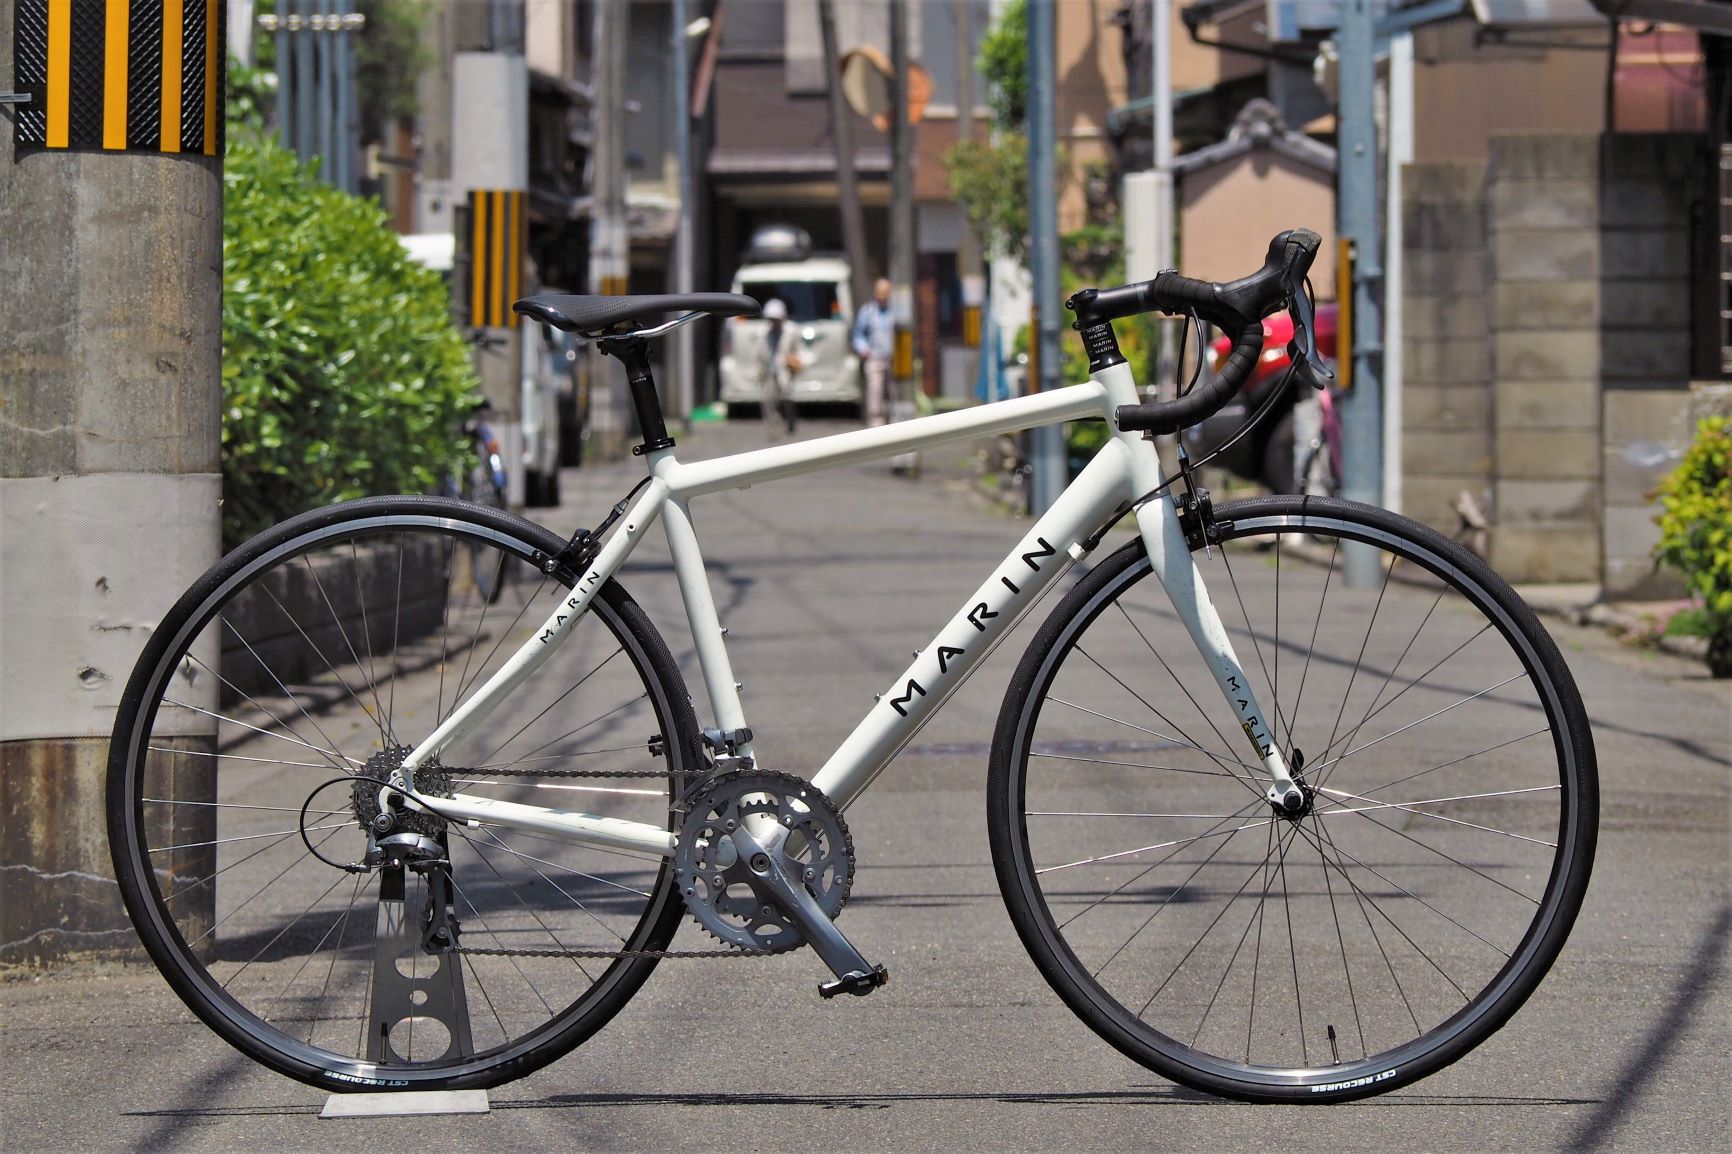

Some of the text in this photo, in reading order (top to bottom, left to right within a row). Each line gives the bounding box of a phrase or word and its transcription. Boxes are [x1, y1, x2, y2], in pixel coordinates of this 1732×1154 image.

[539, 571, 600, 644] MARIN
[890, 537, 1056, 717] MARIN
[1227, 676, 1274, 758] MARIN
[323, 1069, 386, 1086] RECOURSE
[1311, 1069, 1396, 1093] CST RECOURSE
